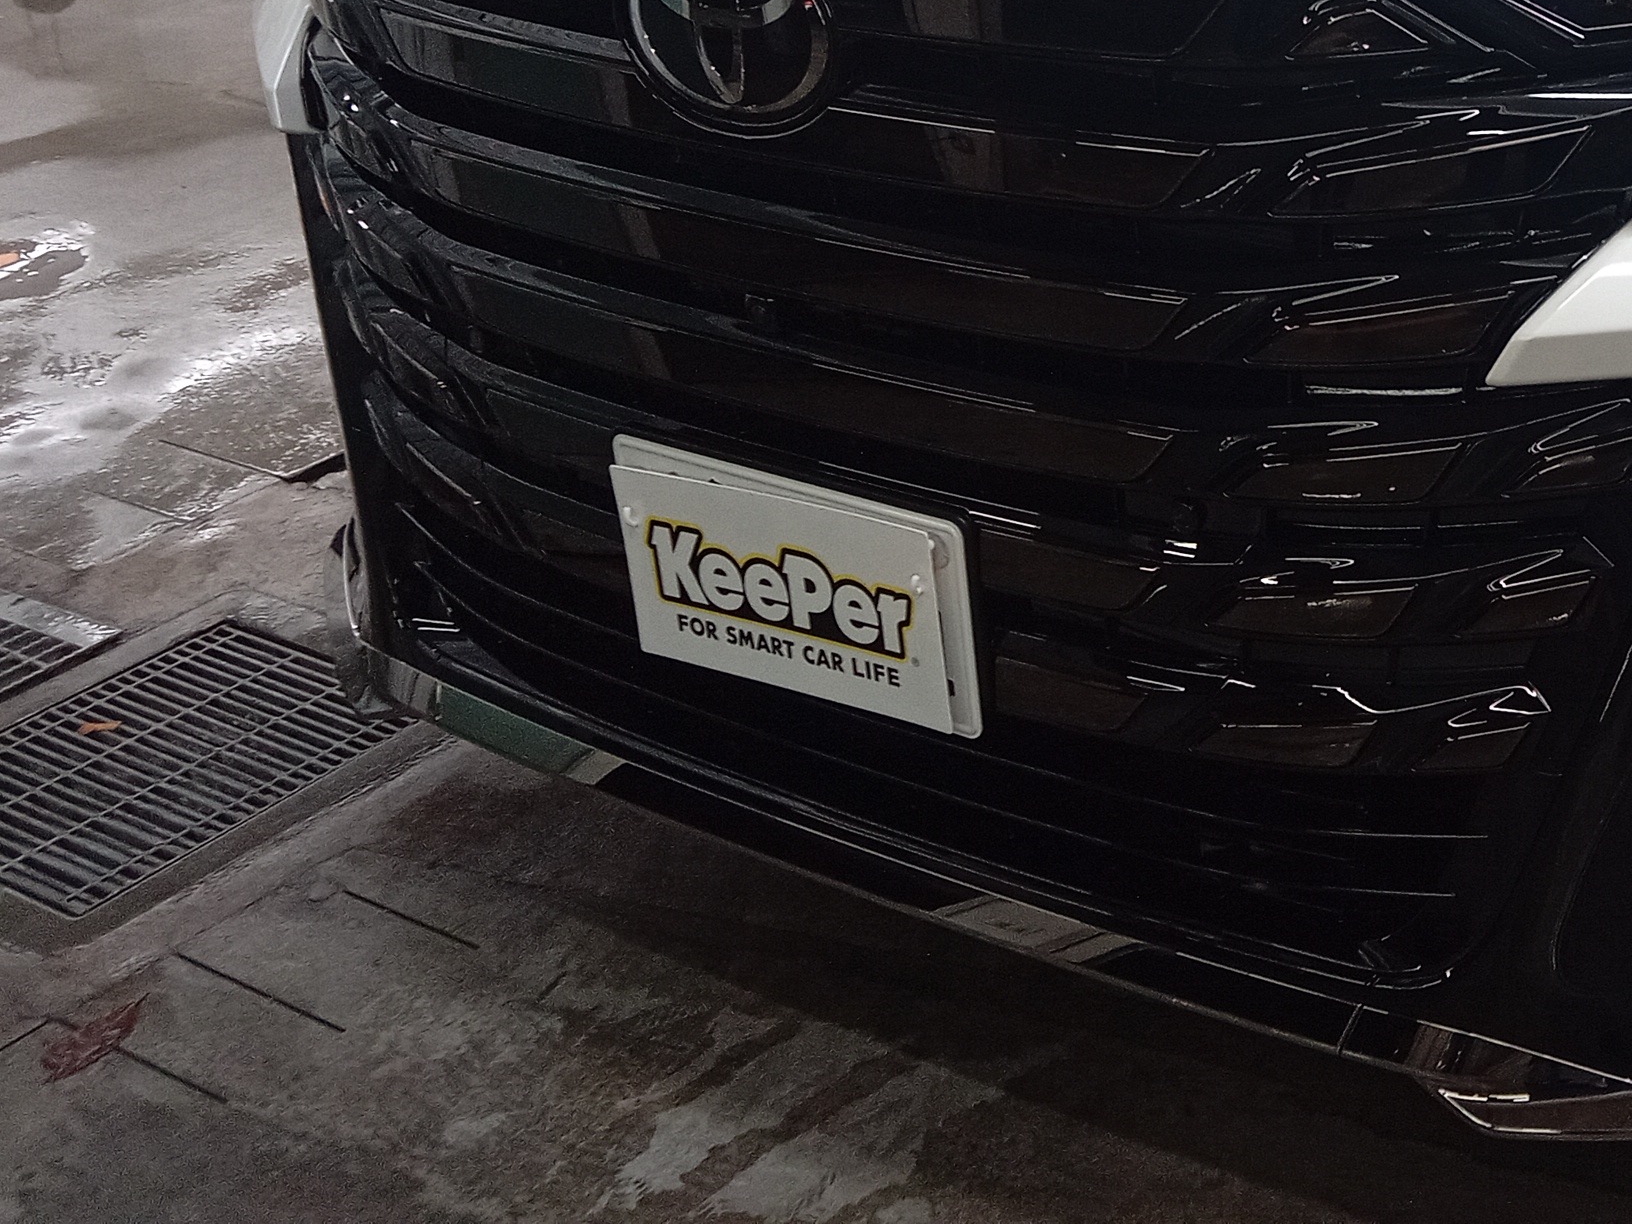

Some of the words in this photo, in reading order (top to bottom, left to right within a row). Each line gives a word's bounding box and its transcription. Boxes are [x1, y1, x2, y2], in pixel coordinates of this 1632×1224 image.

[648, 520, 912, 660] KeePer
[678, 613, 719, 642] FOR
[727, 626, 795, 660] SMART
[804, 645, 845, 673] CAR
[852, 657, 901, 688] LIFE
